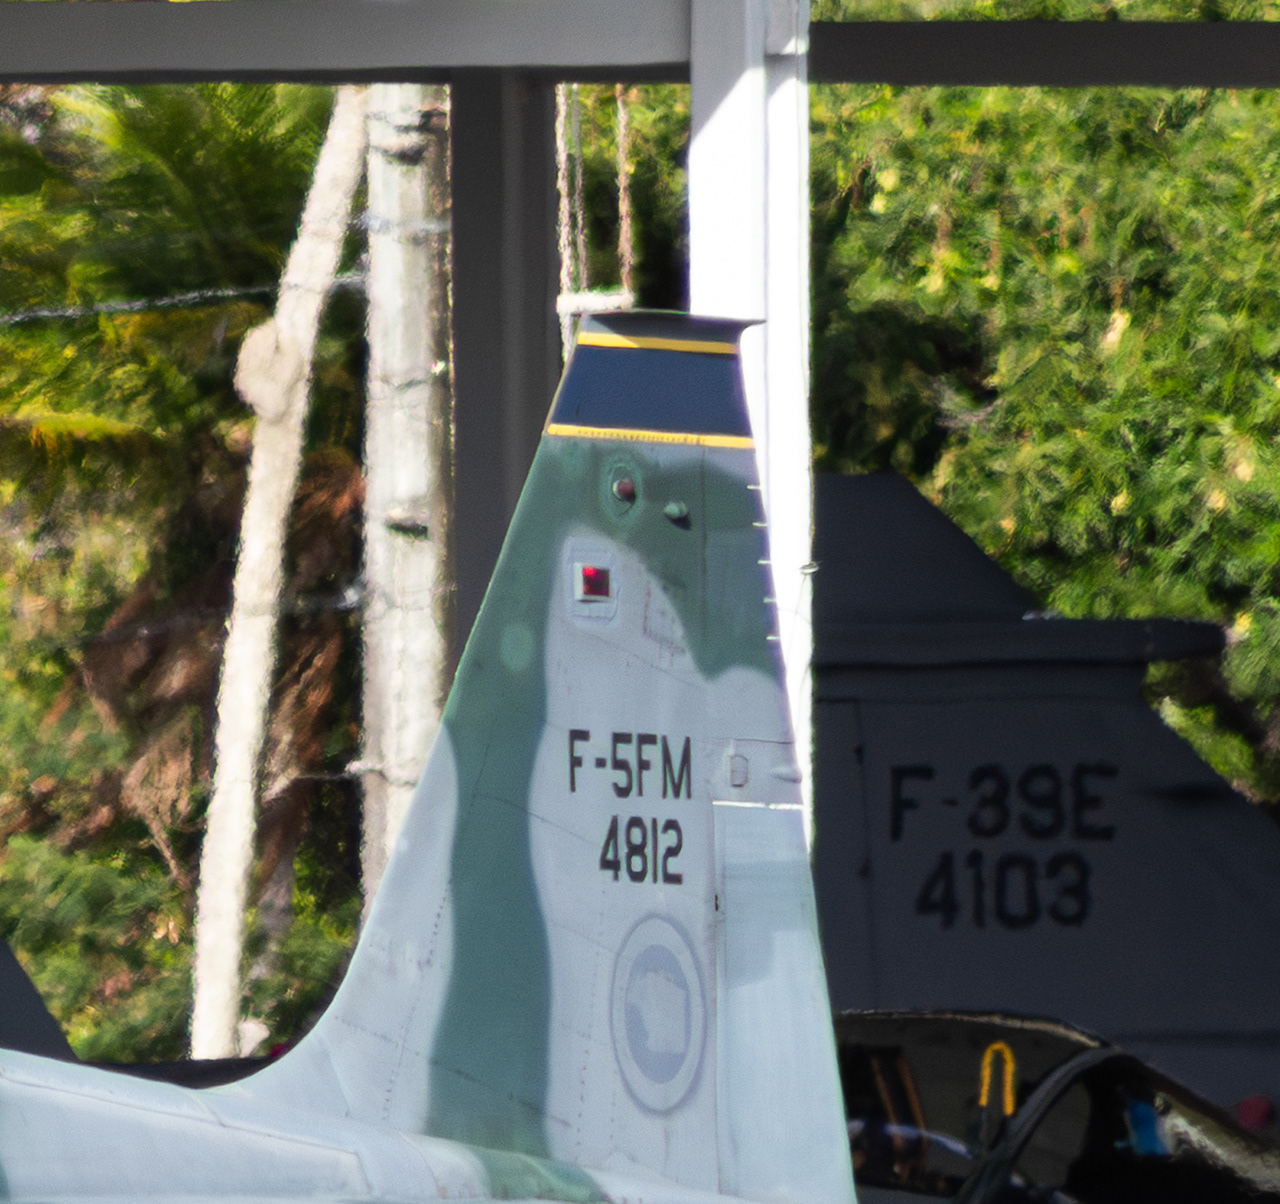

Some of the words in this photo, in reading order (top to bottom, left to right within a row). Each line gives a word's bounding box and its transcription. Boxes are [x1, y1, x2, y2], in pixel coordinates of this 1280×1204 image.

[568, 729, 692, 800] F-5FM
[889, 764, 1119, 841] F-39E
[599, 815, 683, 885] 4812
[914, 850, 1089, 930] 4103
